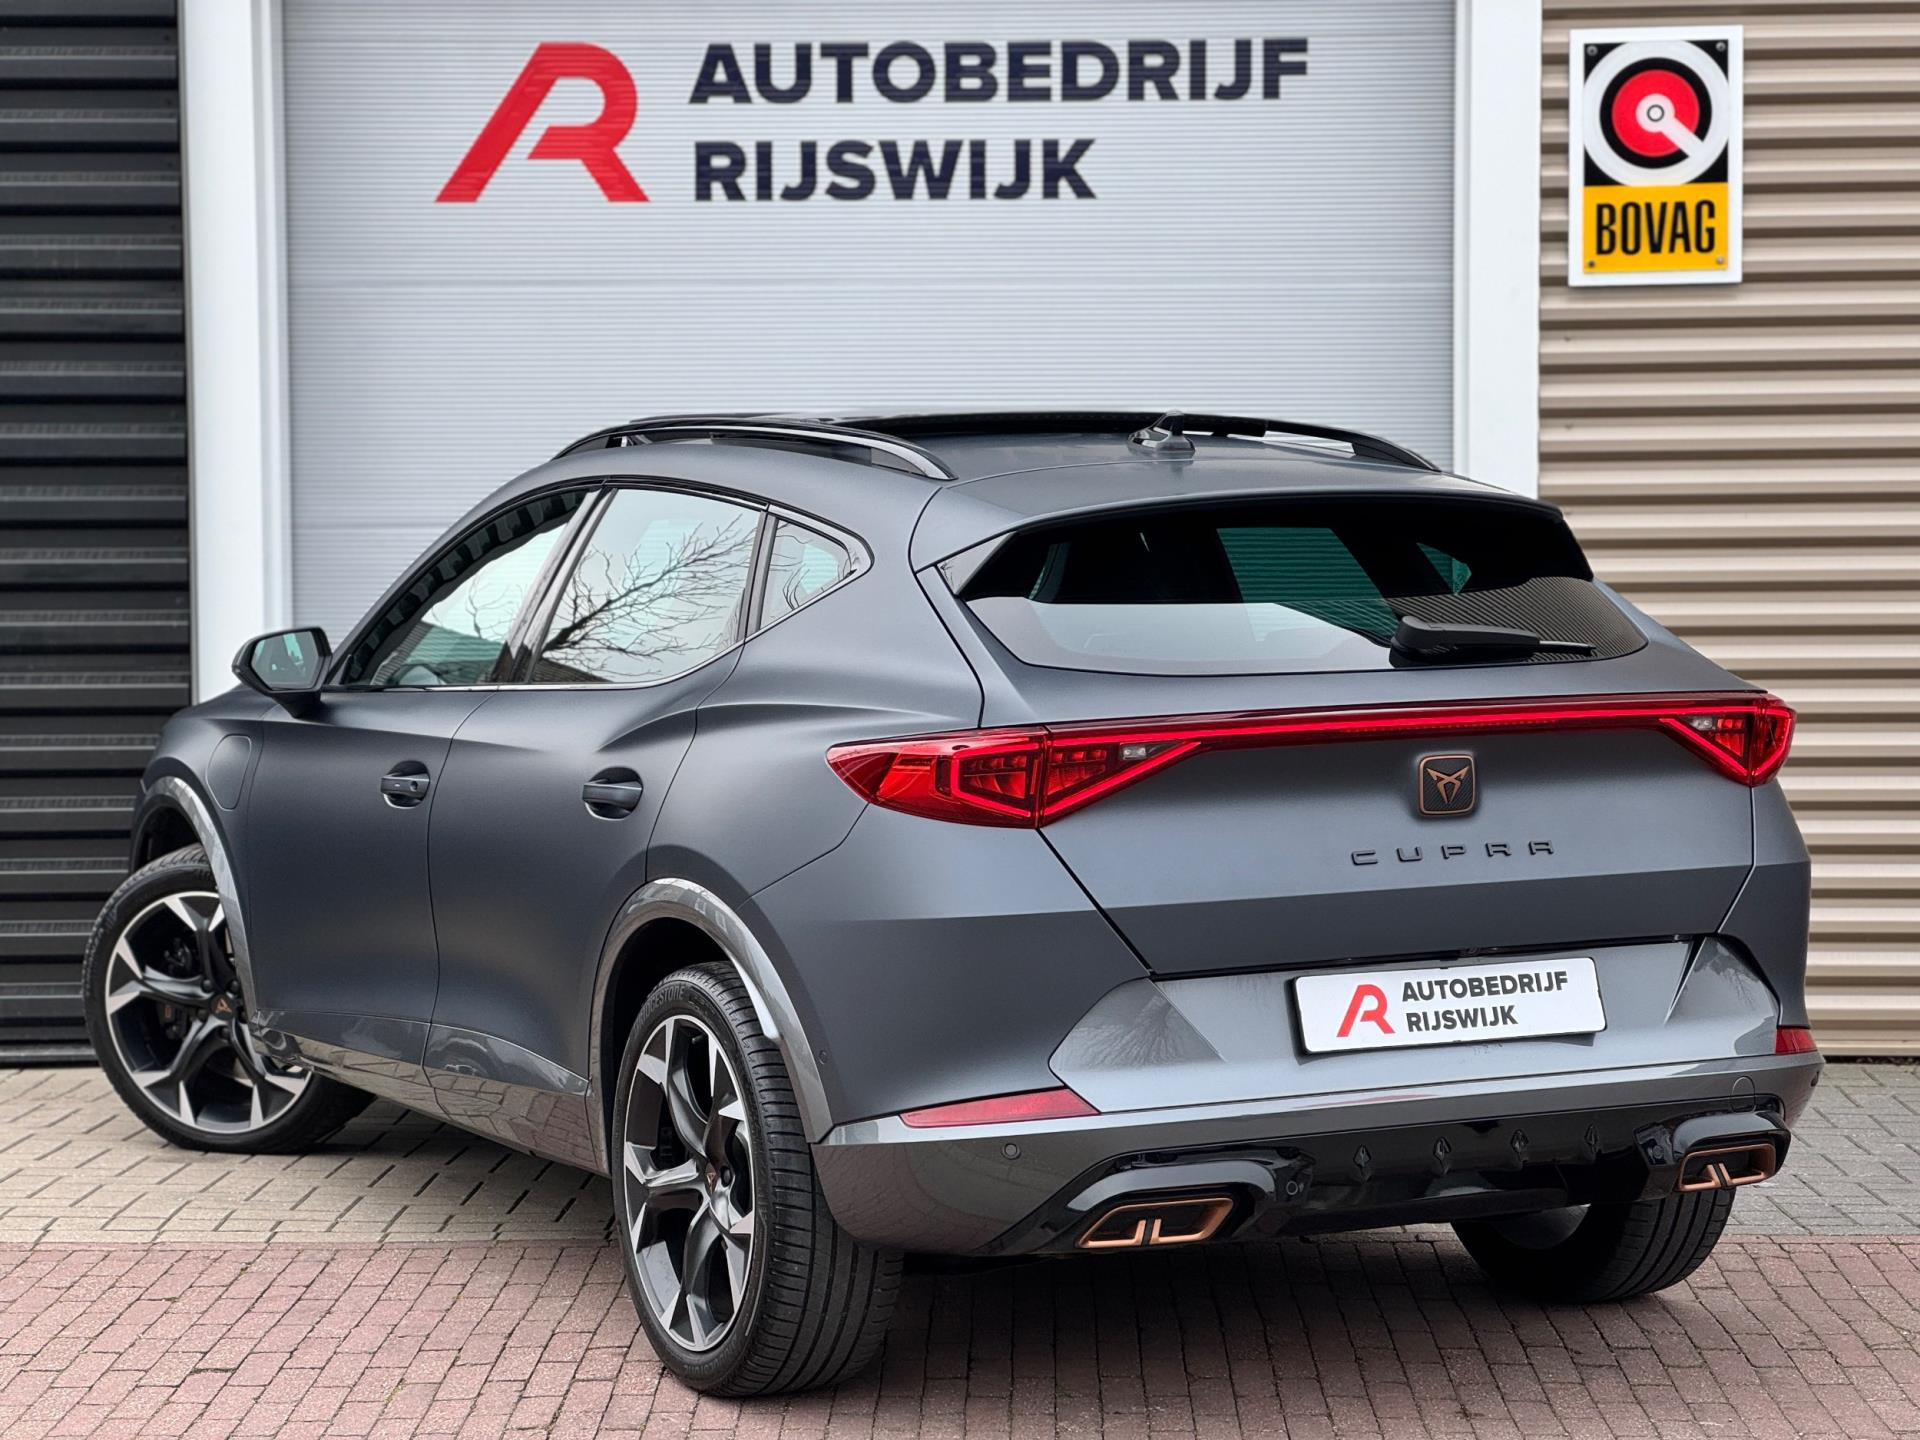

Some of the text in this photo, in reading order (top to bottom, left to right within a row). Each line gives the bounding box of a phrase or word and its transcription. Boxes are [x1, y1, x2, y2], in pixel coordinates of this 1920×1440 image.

[689, 37, 1309, 104] AUTOBEDRIJF
[694, 138, 1096, 201] RIJSWIJK
[1595, 199, 1716, 256] BOVAG
[1351, 840, 1554, 866] CUPRA
[1402, 971, 1568, 1002] AUTOBEDRIJF
[1406, 1005, 1518, 1033] RIJSWIJK
